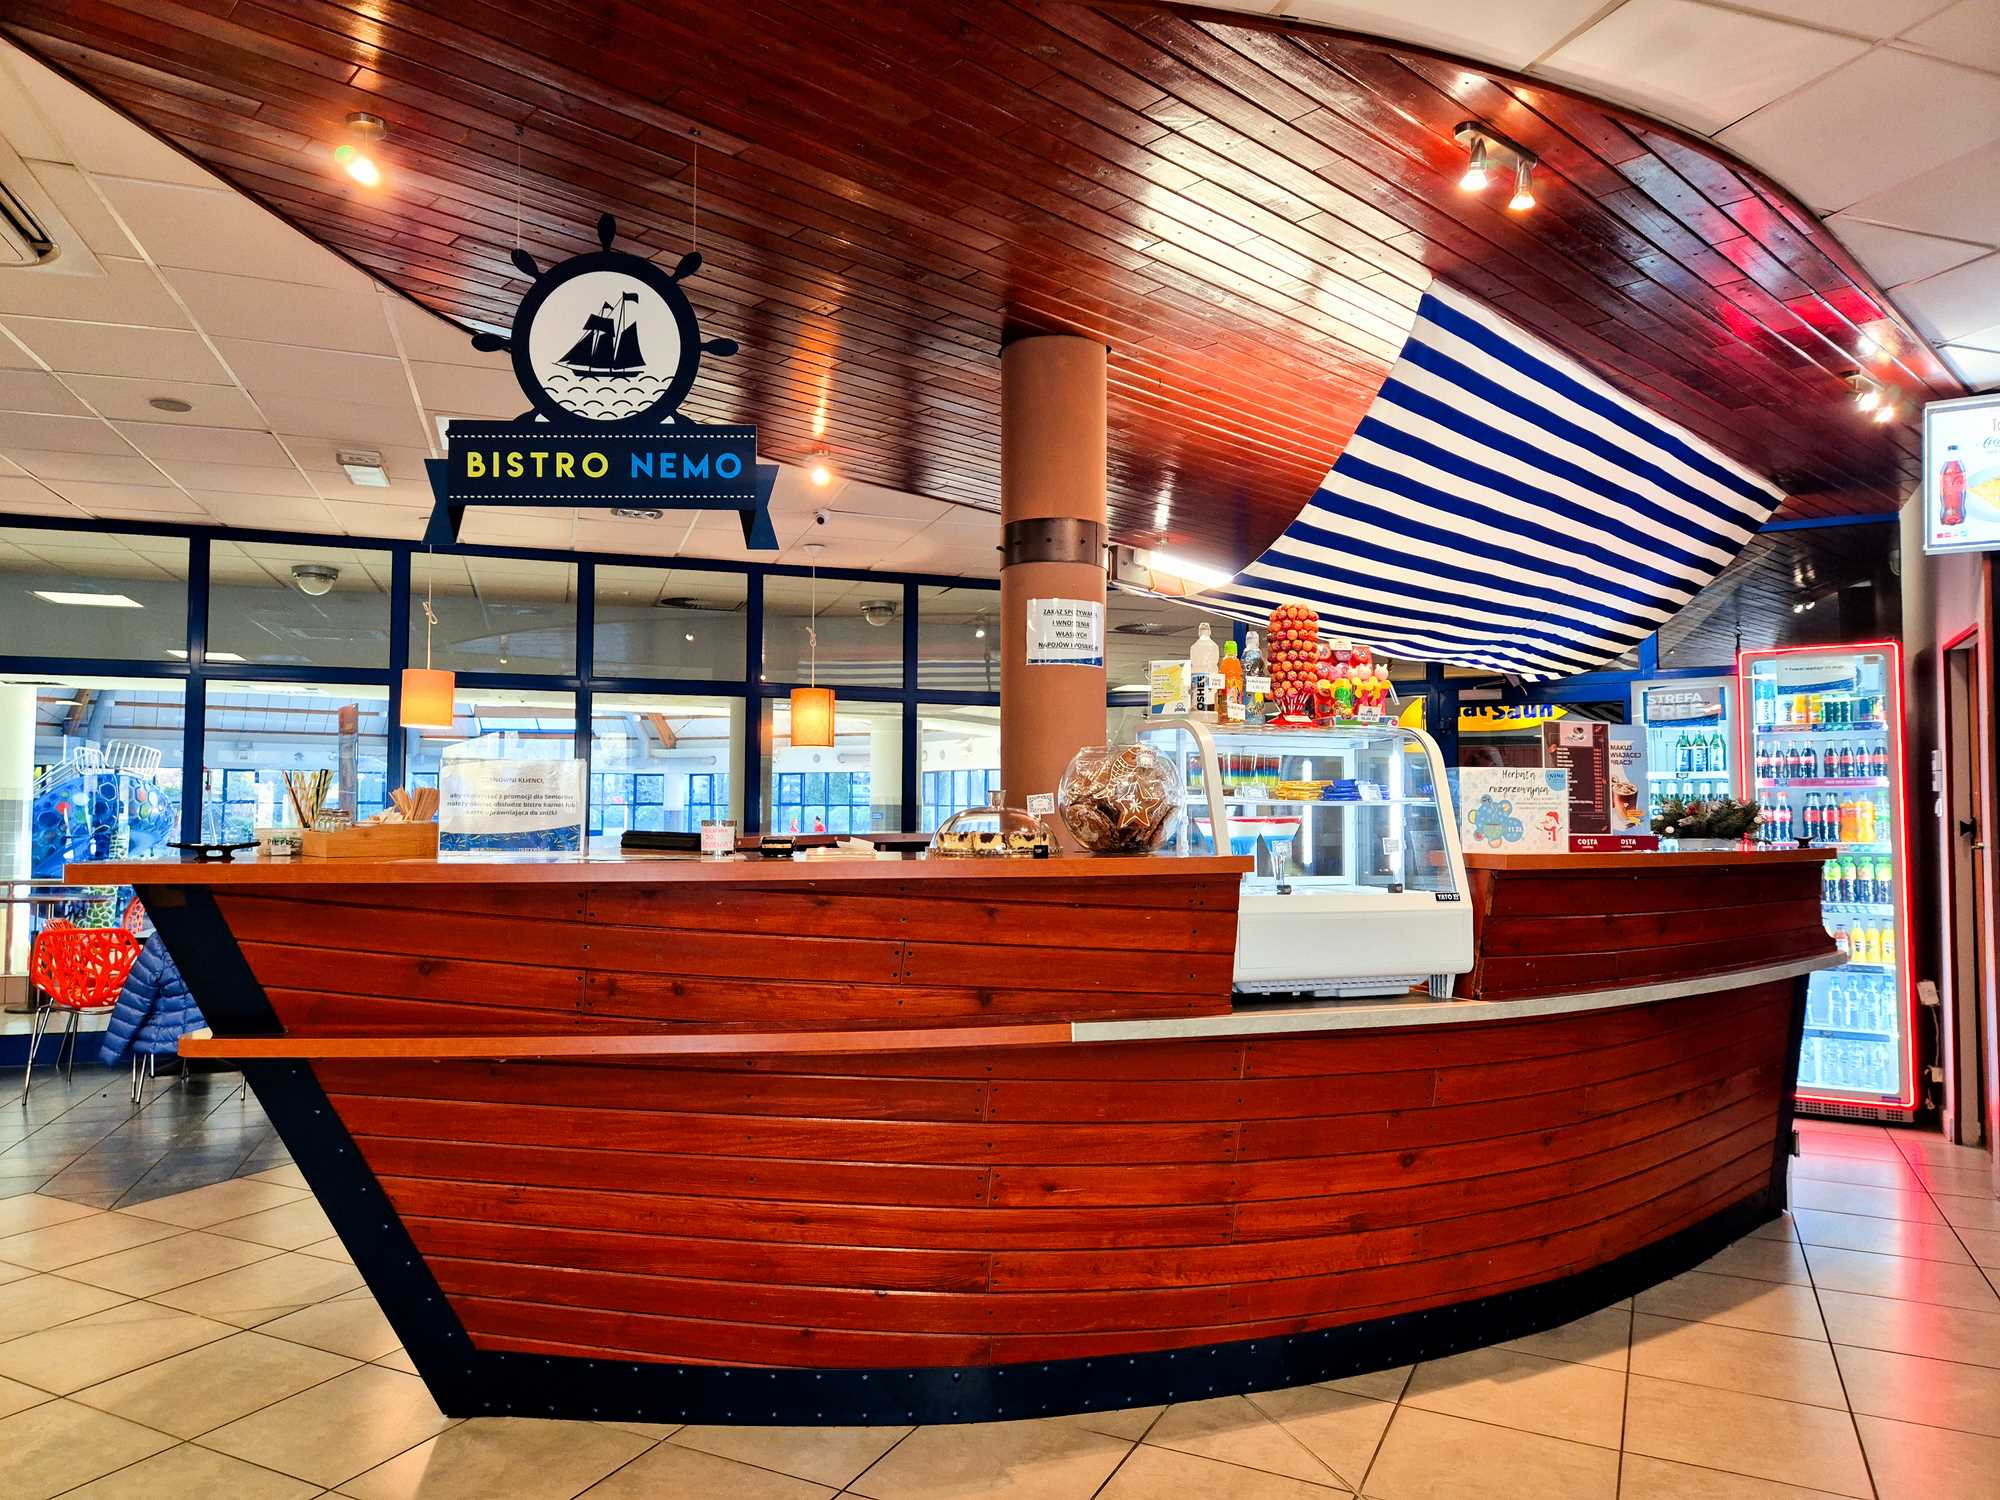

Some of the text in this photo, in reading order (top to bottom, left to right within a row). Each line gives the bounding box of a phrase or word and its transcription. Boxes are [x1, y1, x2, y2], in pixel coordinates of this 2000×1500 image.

[467, 451, 742, 479] BISTRO NEMO
[1043, 607, 1063, 615] ZAKAZ
[1055, 631, 1088, 639] WŁASYCH
[1647, 692, 1703, 705] STREFA
[1502, 769, 1536, 780] Herbata
[1577, 838, 1598, 846] COSTA
